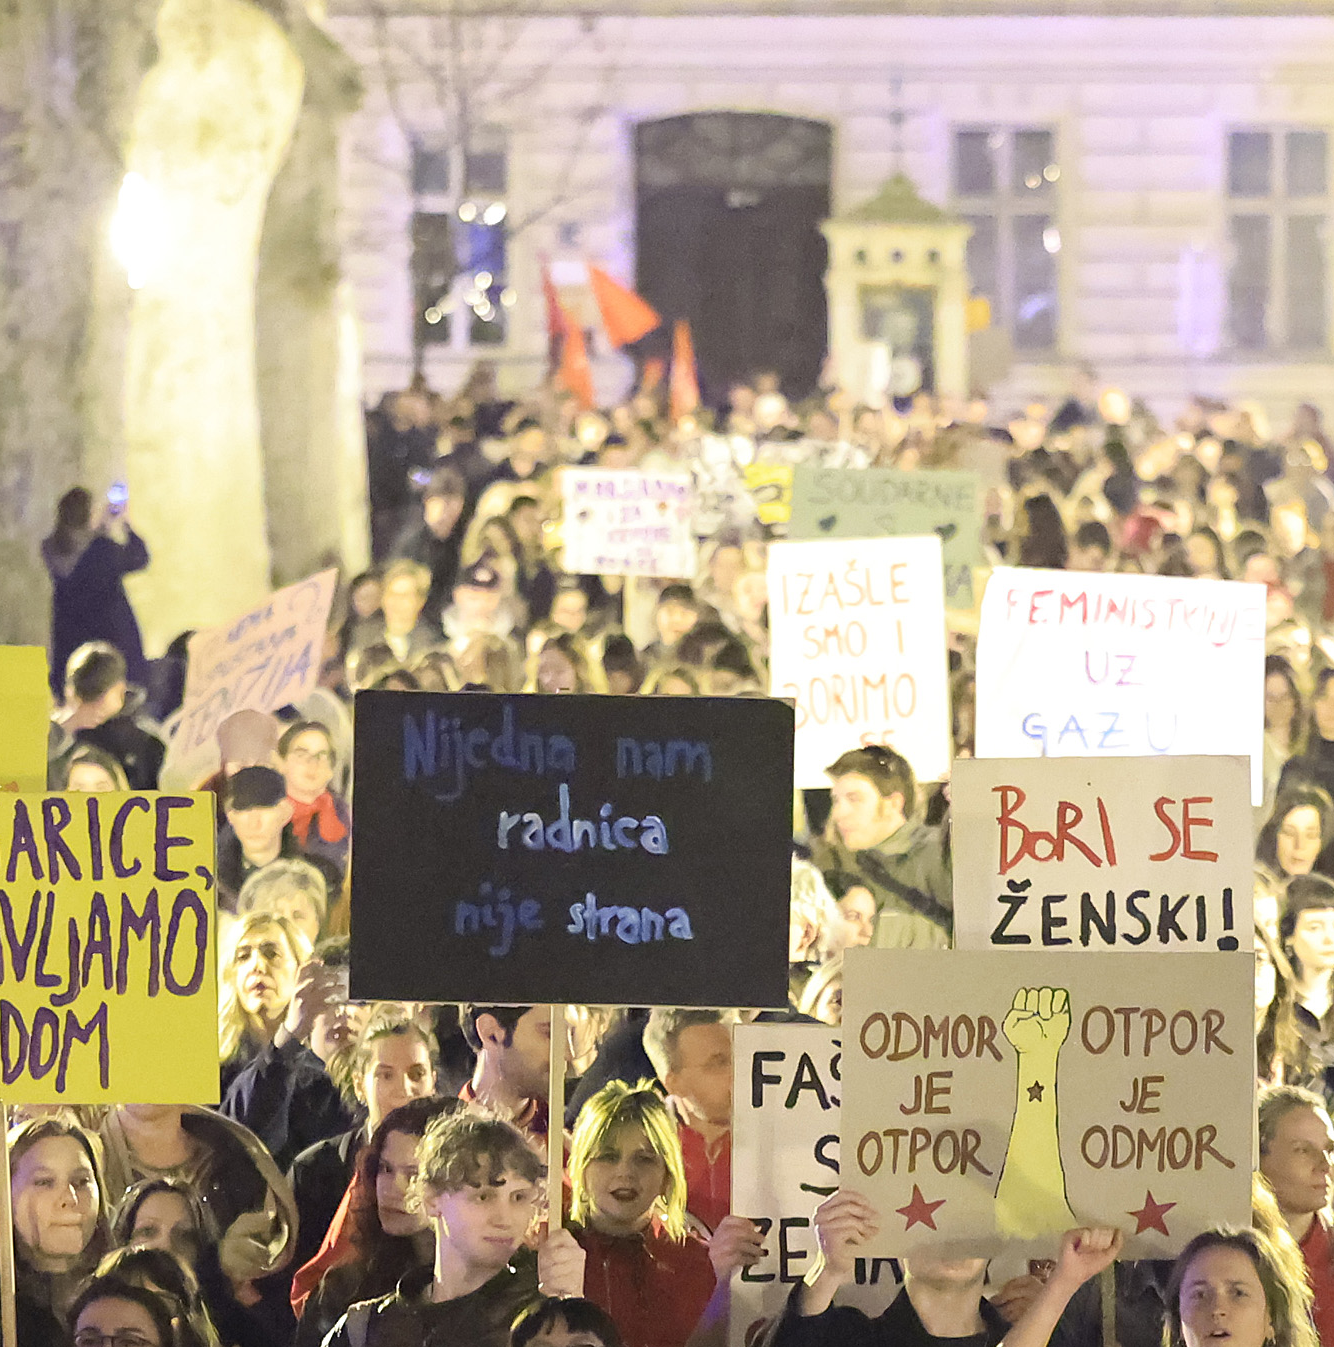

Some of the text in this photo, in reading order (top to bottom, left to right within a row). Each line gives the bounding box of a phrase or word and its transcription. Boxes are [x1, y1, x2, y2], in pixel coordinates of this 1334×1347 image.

[782, 559, 910, 616] IZAŠLE
[803, 619, 904, 660] SMO I
[1007, 589, 1264, 647] FEMINISTKINJE
[1085, 650, 1143, 686] UZ
[401, 706, 713, 800] Nijedna nam
[1022, 712, 1178, 757] GAZU
[497, 784, 668, 855] radnica
[1149, 796, 1220, 863] SE
[453, 881, 694, 956] nije strana
[990, 878, 1239, 951] ŽENSKI!
[859, 1011, 1004, 1062] ODMOR
[1080, 1006, 1234, 1057] OTPOR
[899, 1071, 954, 1115] JE
[1120, 1075, 1165, 1113] JE
[856, 1128, 993, 1177] OTPOR
[1080, 1124, 1235, 1171] ODMOR
